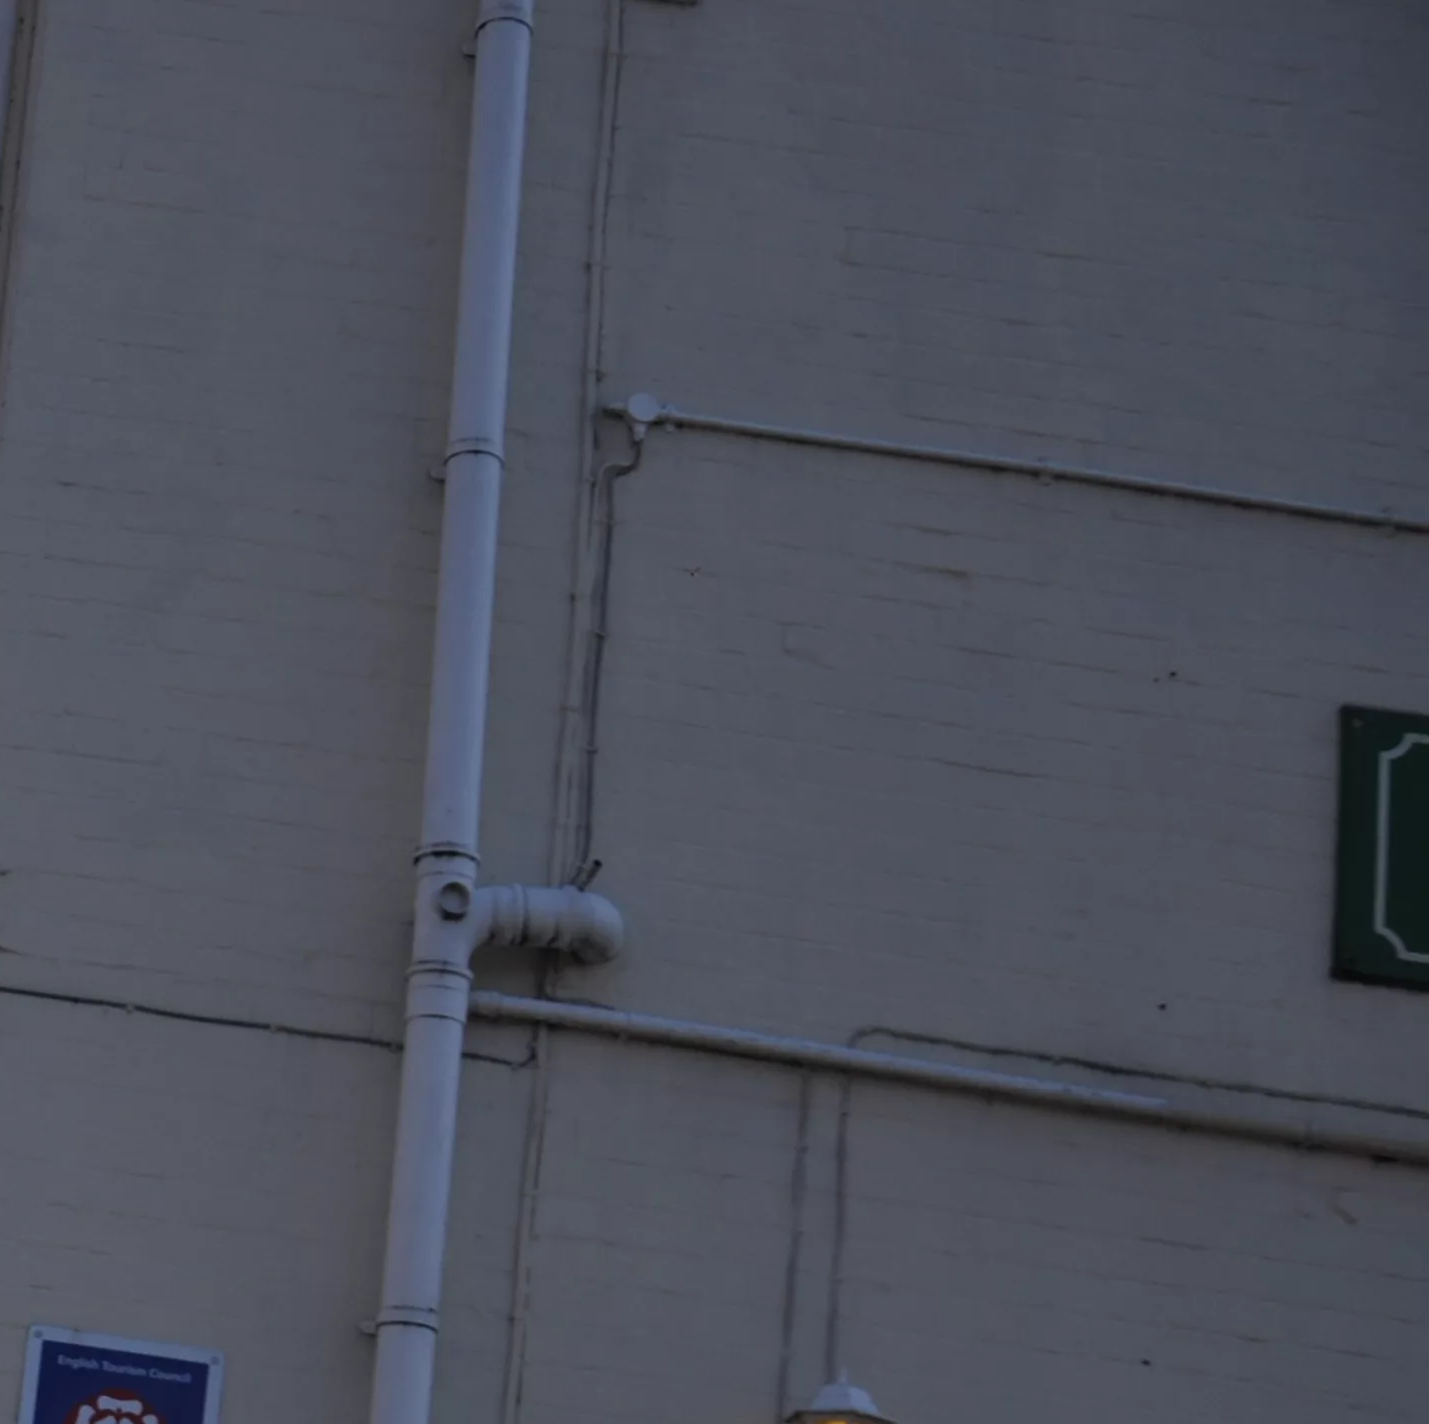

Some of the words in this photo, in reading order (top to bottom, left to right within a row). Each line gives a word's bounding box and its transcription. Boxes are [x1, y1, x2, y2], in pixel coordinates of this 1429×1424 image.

[57, 1354, 100, 1370] English
[101, 1360, 147, 1377] Tourism
[148, 1367, 192, 1384] Council
